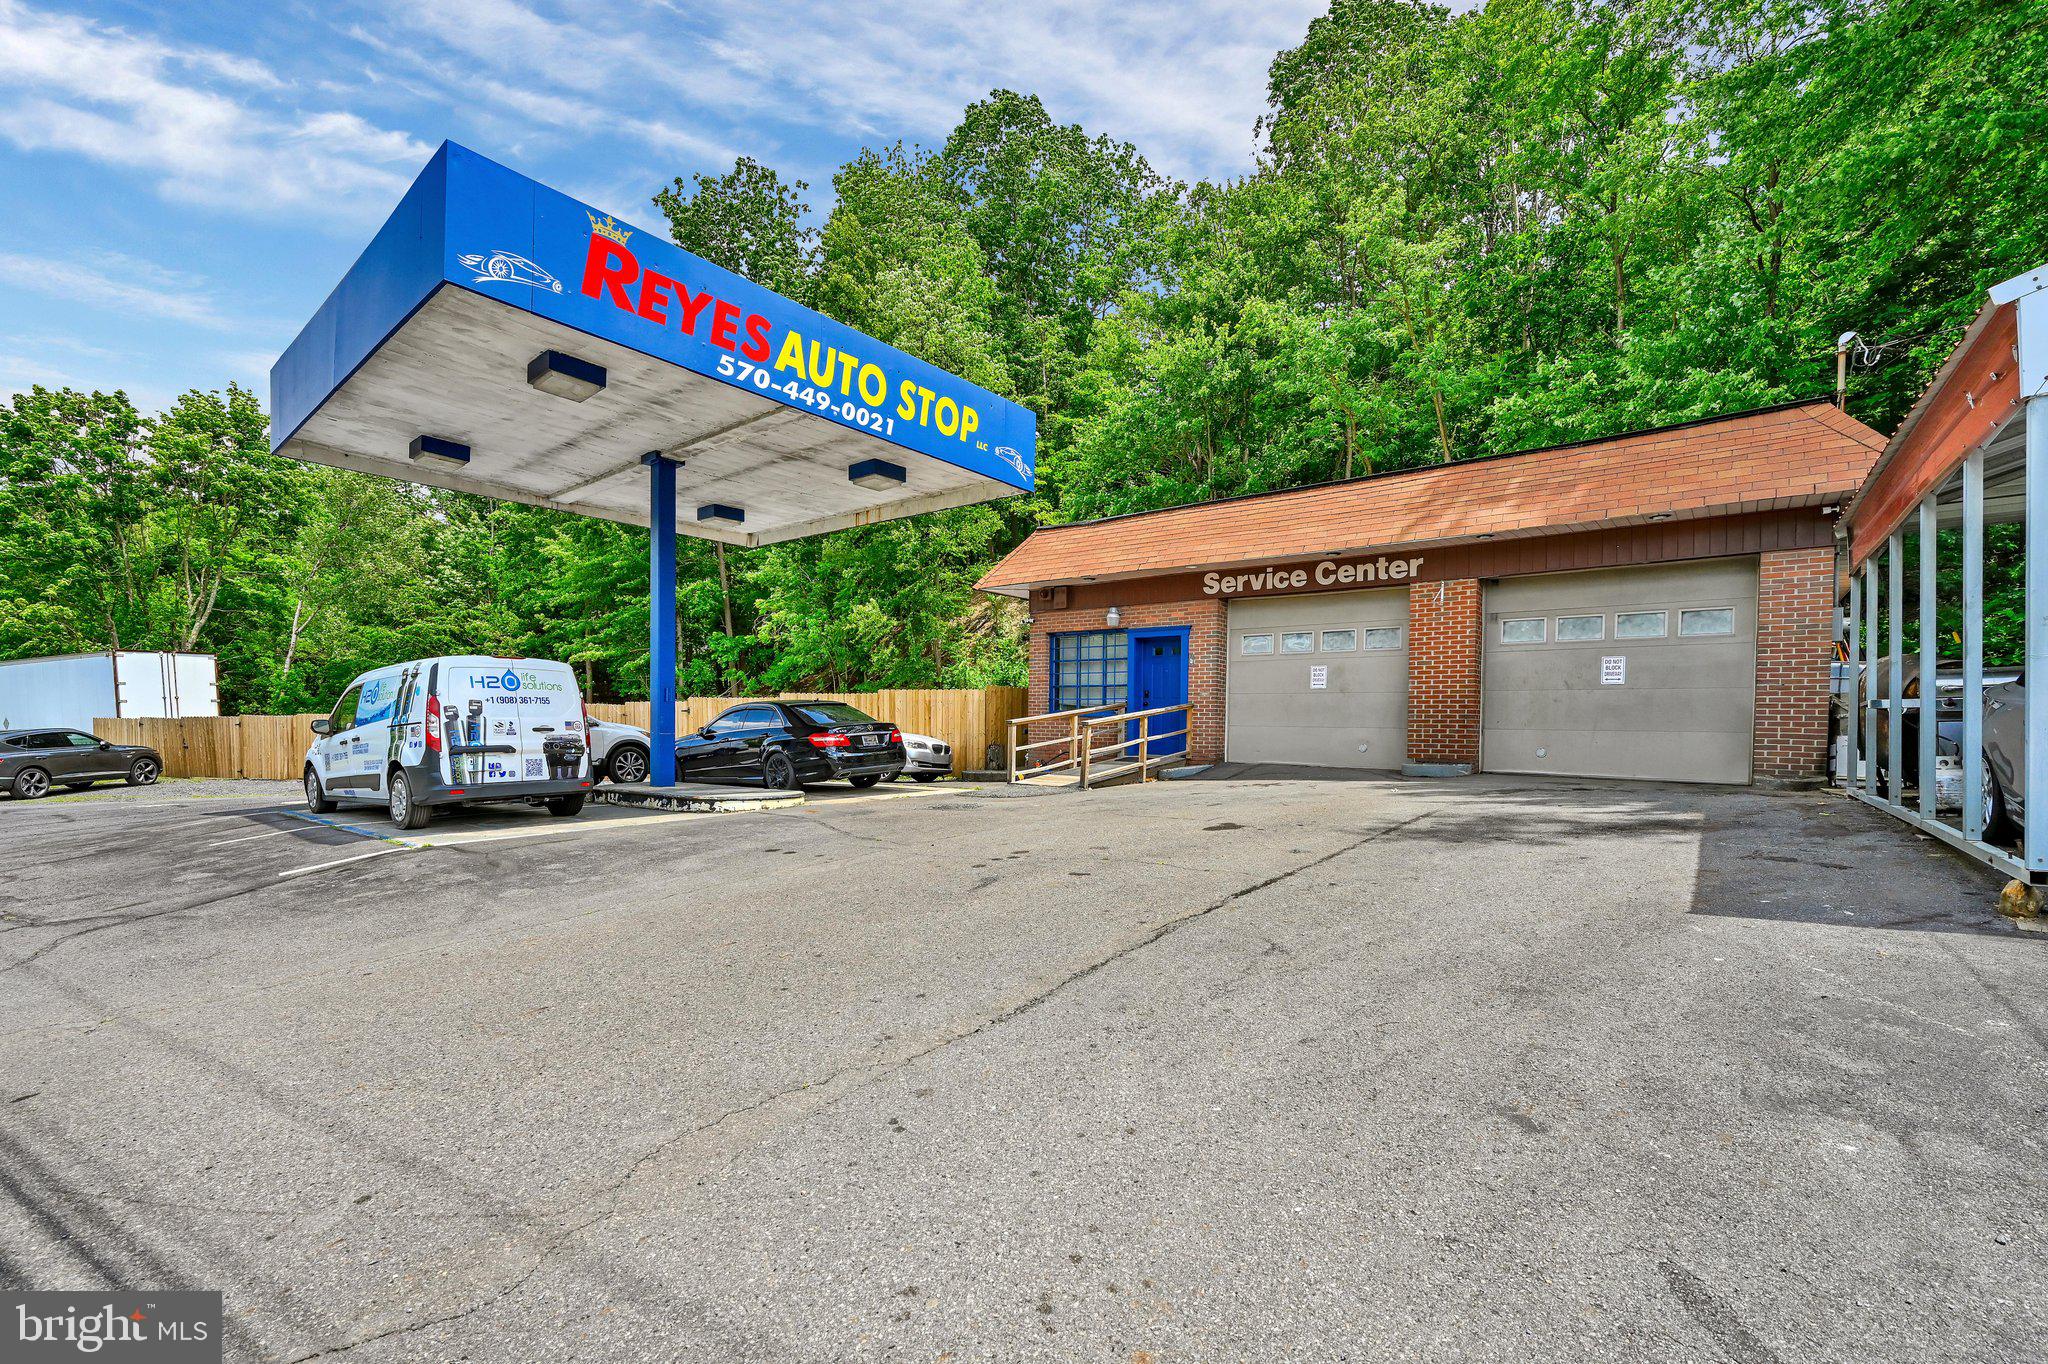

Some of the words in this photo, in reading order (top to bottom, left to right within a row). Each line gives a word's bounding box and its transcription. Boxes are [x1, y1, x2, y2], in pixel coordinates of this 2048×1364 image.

[581, 231, 772, 363] REYES
[773, 329, 887, 407] AUTO
[896, 379, 979, 442] STOP
[976, 440, 988, 452] LLC
[716, 353, 894, 436] 570-449-0021
[1203, 567, 1308, 596] Service
[1315, 556, 1424, 586] Center
[521, 673, 536, 681] life
[522, 681, 563, 691] solutions
[496, 696, 517, 704] (908)
[519, 697, 551, 705] 361-7155
